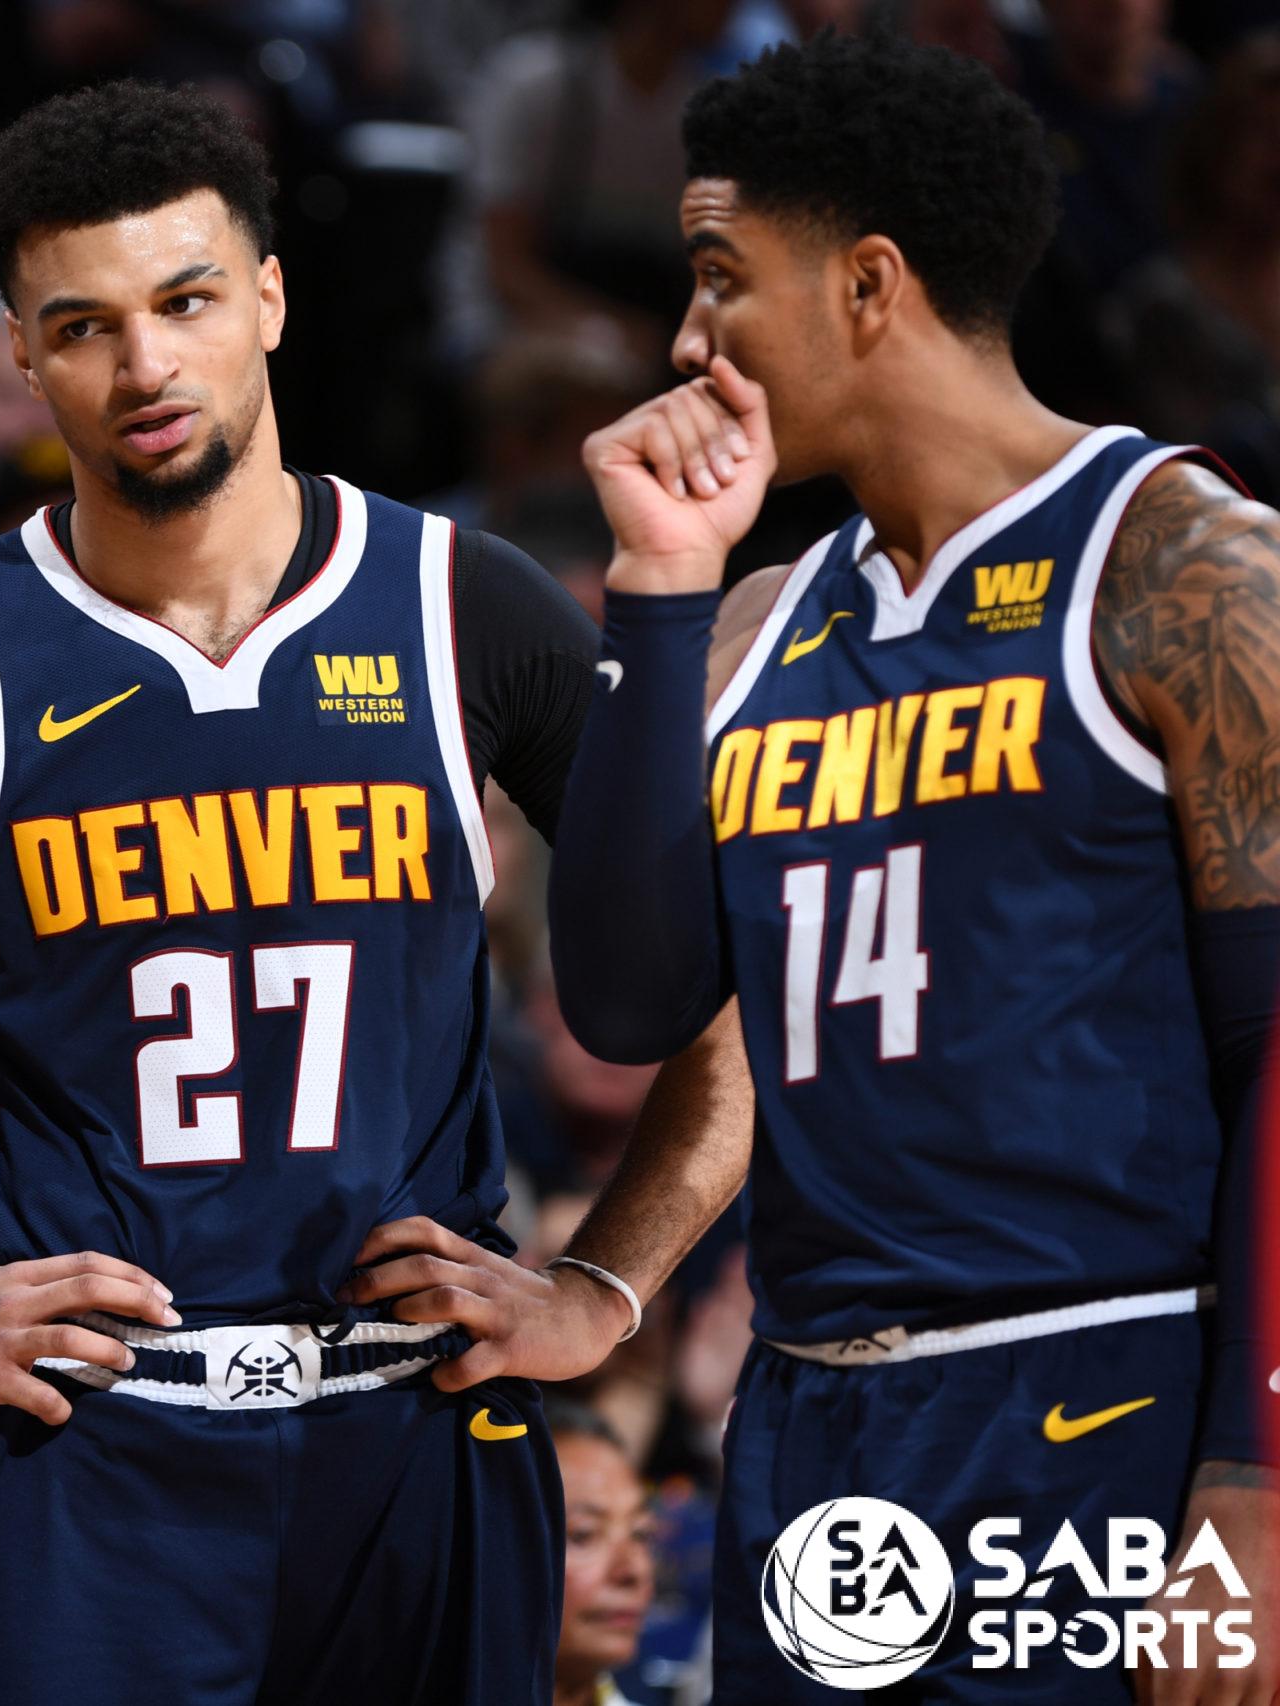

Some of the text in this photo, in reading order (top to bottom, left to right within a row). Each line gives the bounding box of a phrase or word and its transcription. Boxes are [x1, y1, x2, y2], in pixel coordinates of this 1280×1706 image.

[975, 558, 1055, 609] WU
[967, 601, 1045, 625] WESTERN
[985, 615, 1041, 634] UNION
[314, 654, 399, 695] WU
[319, 699, 403, 710] WESTERN
[346, 711, 406, 723] UNION
[709, 676, 1046, 844] DENVER
[10, 781, 433, 941] DENVER
[781, 842, 928, 1086] 14
[128, 940, 357, 1168] 27
